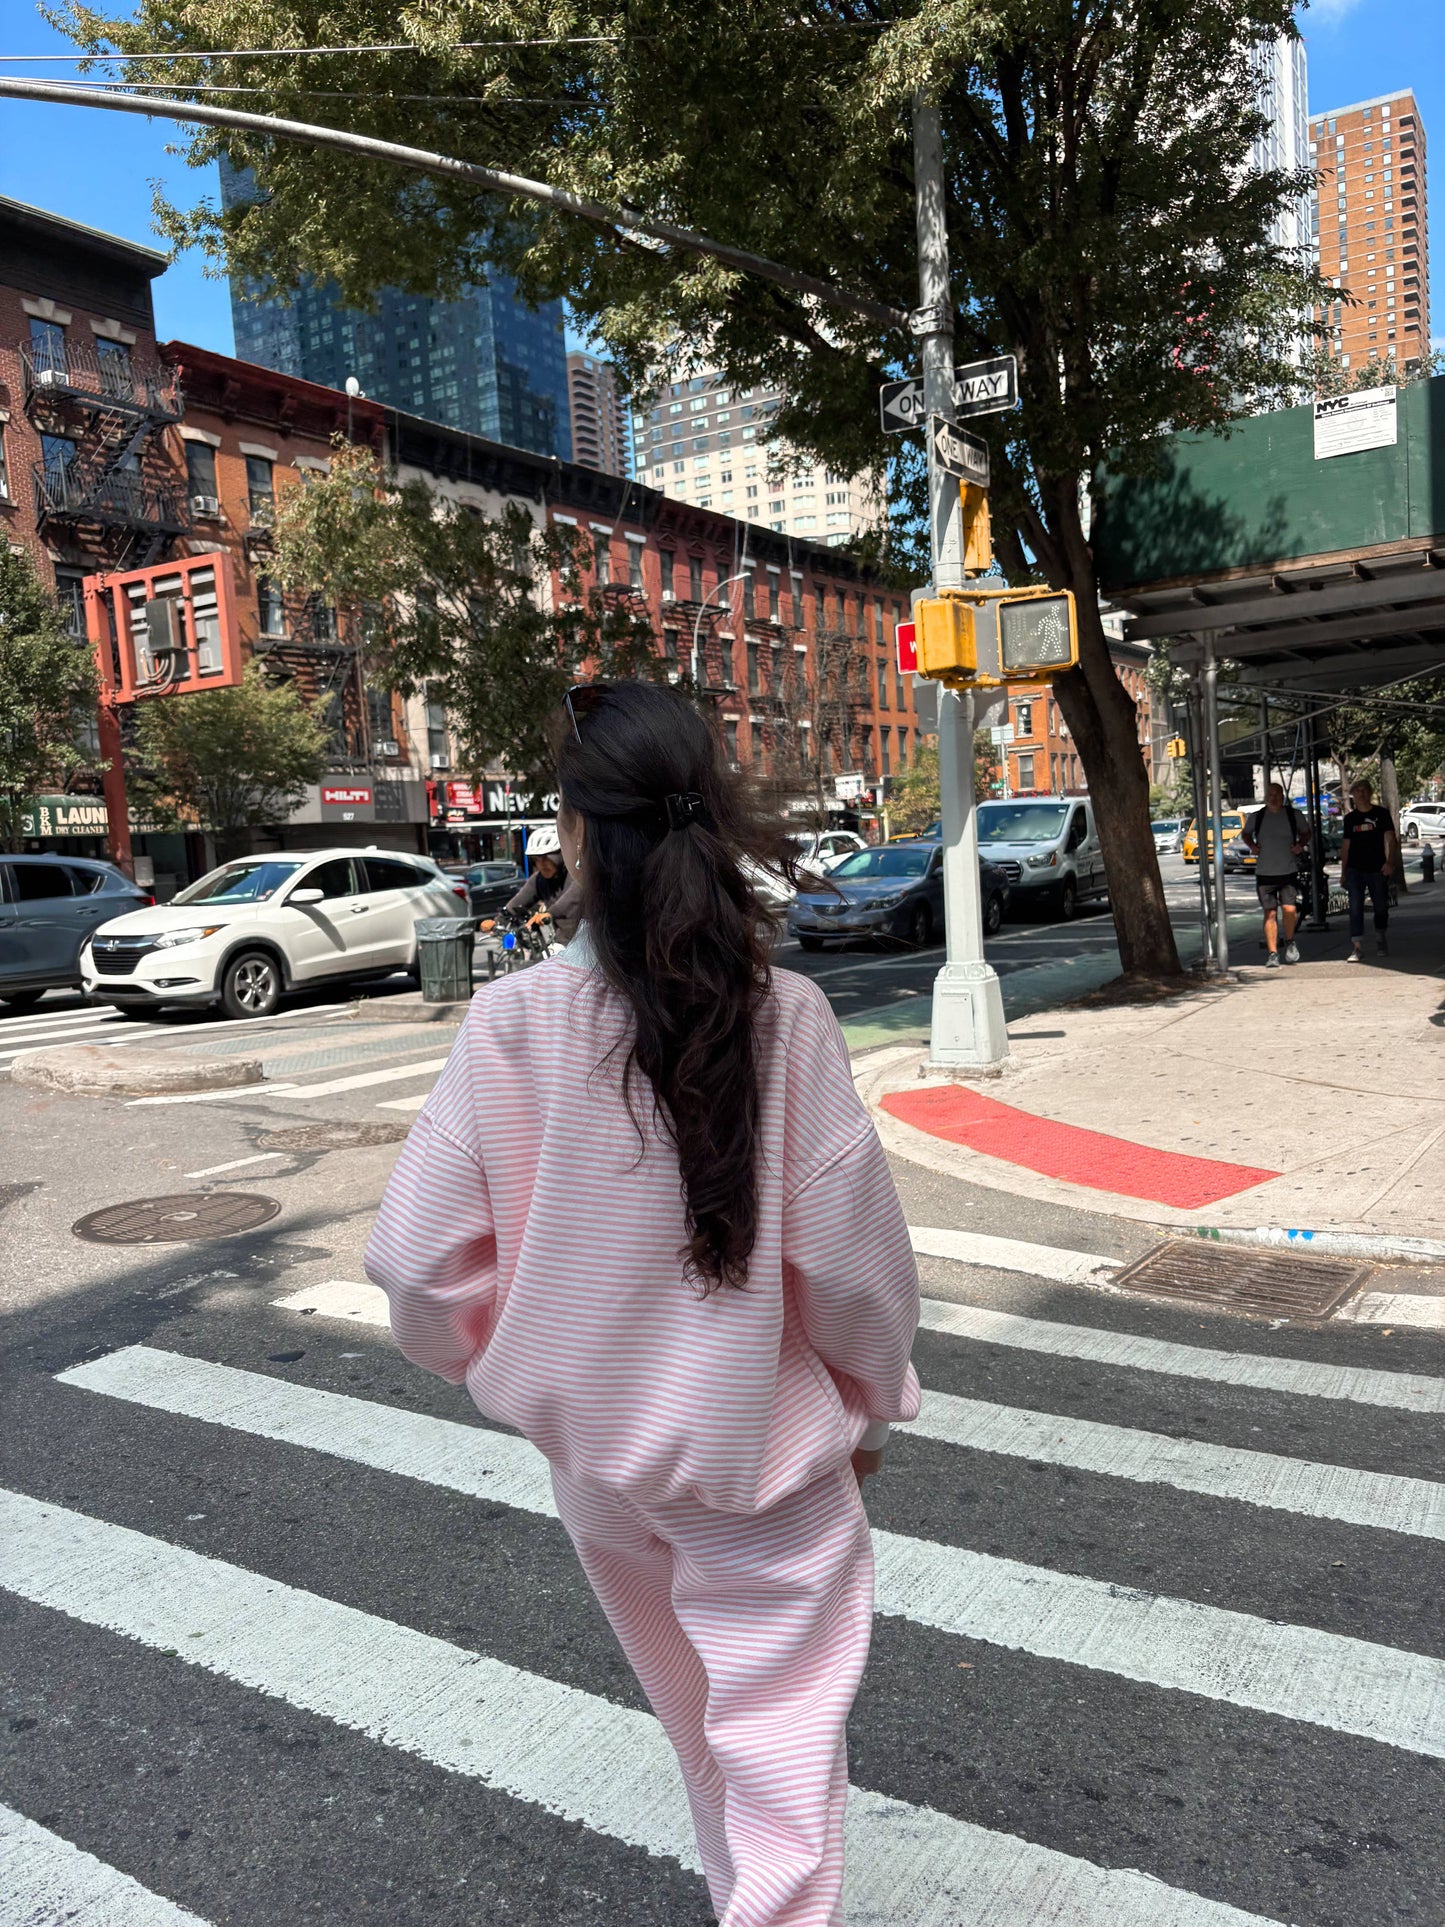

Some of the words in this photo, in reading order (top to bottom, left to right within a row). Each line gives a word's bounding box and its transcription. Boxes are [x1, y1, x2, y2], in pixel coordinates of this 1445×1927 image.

[900, 393, 925, 414] ON
[960, 374, 1002, 401] WAY
[1317, 397, 1349, 413] NYC
[941, 435, 958, 460] ONE
[966, 449, 985, 469] WAY
[325, 790, 369, 801] HILTI
[489, 788, 534, 812] NEW
[541, 792, 560, 811] YO
[56, 807, 108, 825] LAUN
[55, 826, 69, 835] DRY
[72, 825, 104, 834] CLEANER
